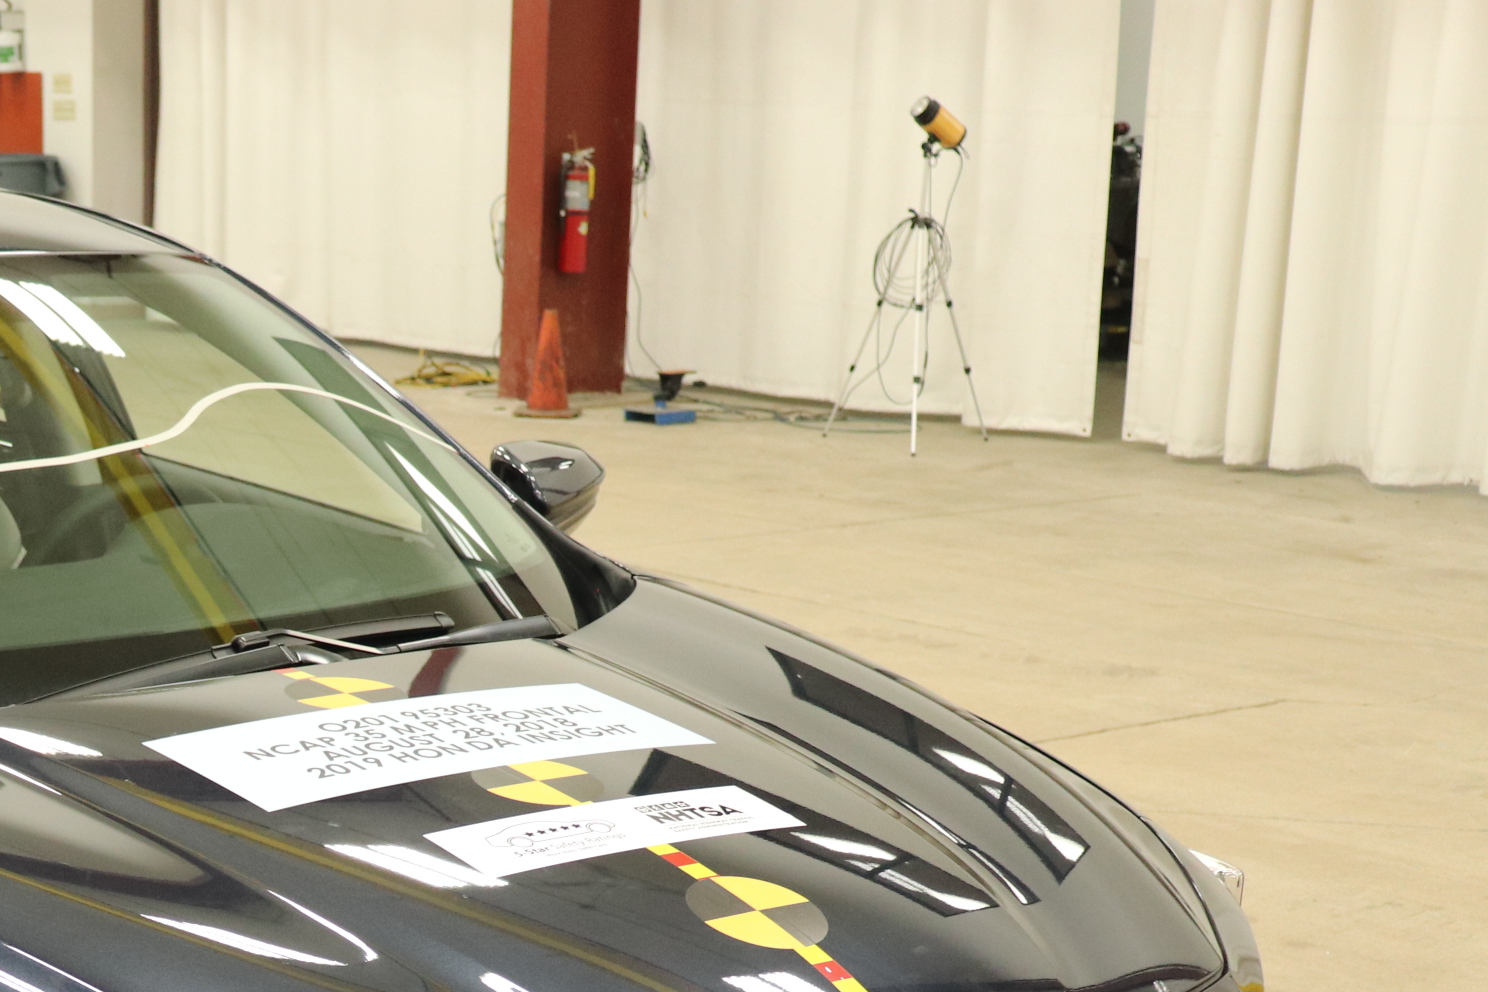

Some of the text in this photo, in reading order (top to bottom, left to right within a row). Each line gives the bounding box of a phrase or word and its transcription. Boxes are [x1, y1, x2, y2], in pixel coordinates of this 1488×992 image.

[242, 736, 337, 761] NCAP
[344, 728, 388, 742] 35
[466, 703, 603, 724] FRONTAL
[306, 757, 384, 779] 2019
[516, 723, 638, 744] INSIGHT
[322, 732, 446, 762] AUGUST
[502, 717, 579, 734] 2018
[645, 804, 745, 824] NHTSA
[514, 832, 627, 857] 5-Star Safety Ratings
